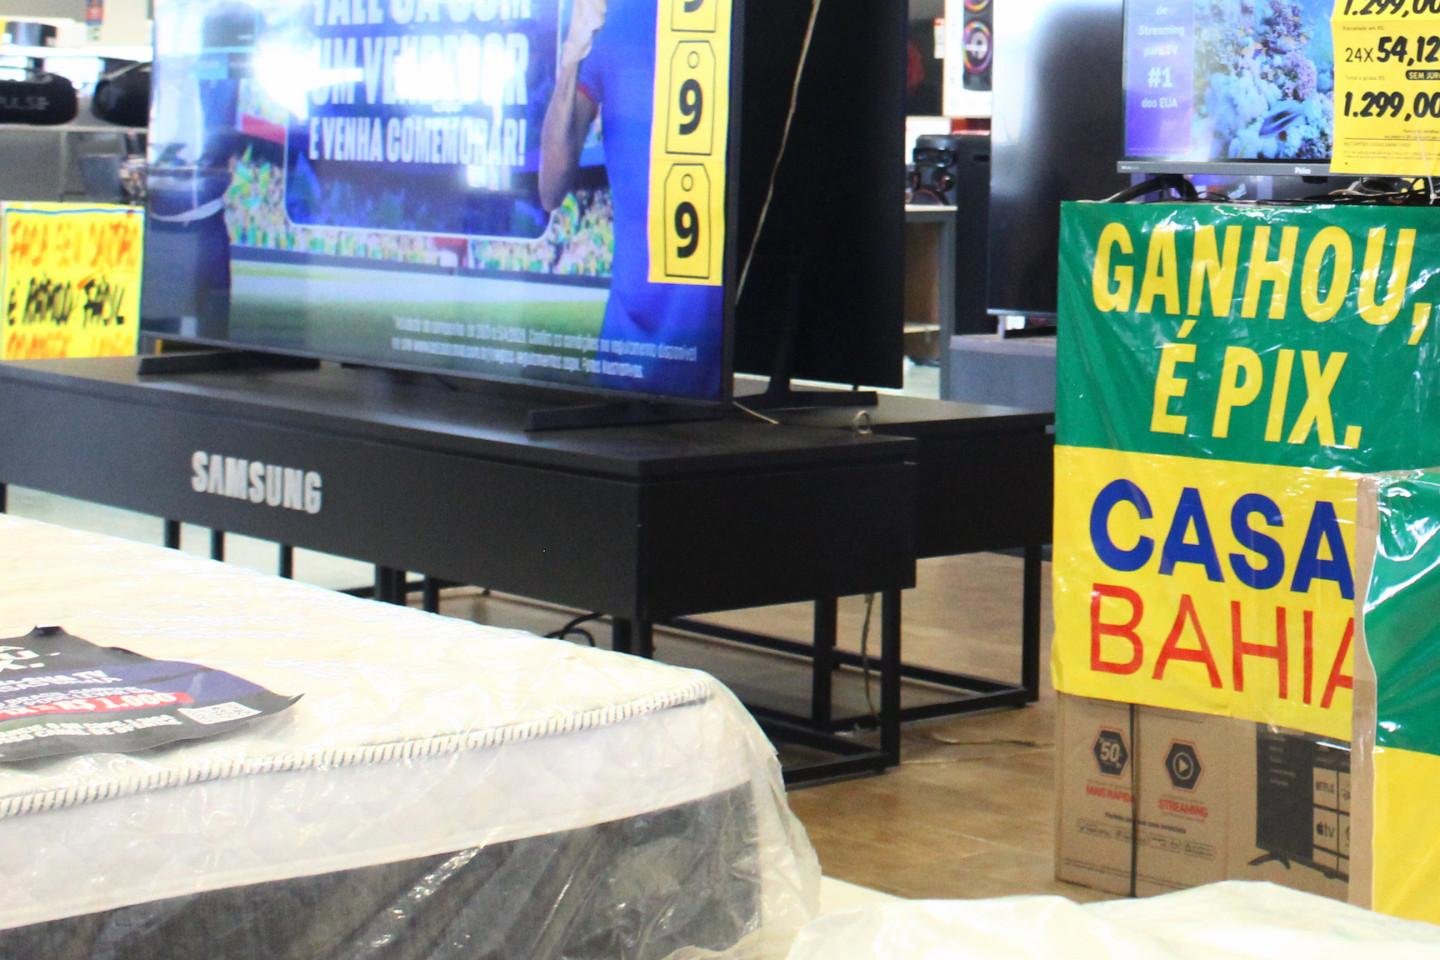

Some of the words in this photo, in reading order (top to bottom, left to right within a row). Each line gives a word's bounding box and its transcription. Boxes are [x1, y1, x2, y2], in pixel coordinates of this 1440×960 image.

[1146, 66, 1174, 88] #1
[1408, 71, 1425, 80] SEM
[321, 116, 384, 162] VENHA
[1091, 221, 1433, 347] GANHOU,
[1149, 319, 1198, 436] É
[1211, 346, 1363, 450] PIX.
[191, 450, 322, 515] SAMSUNG
